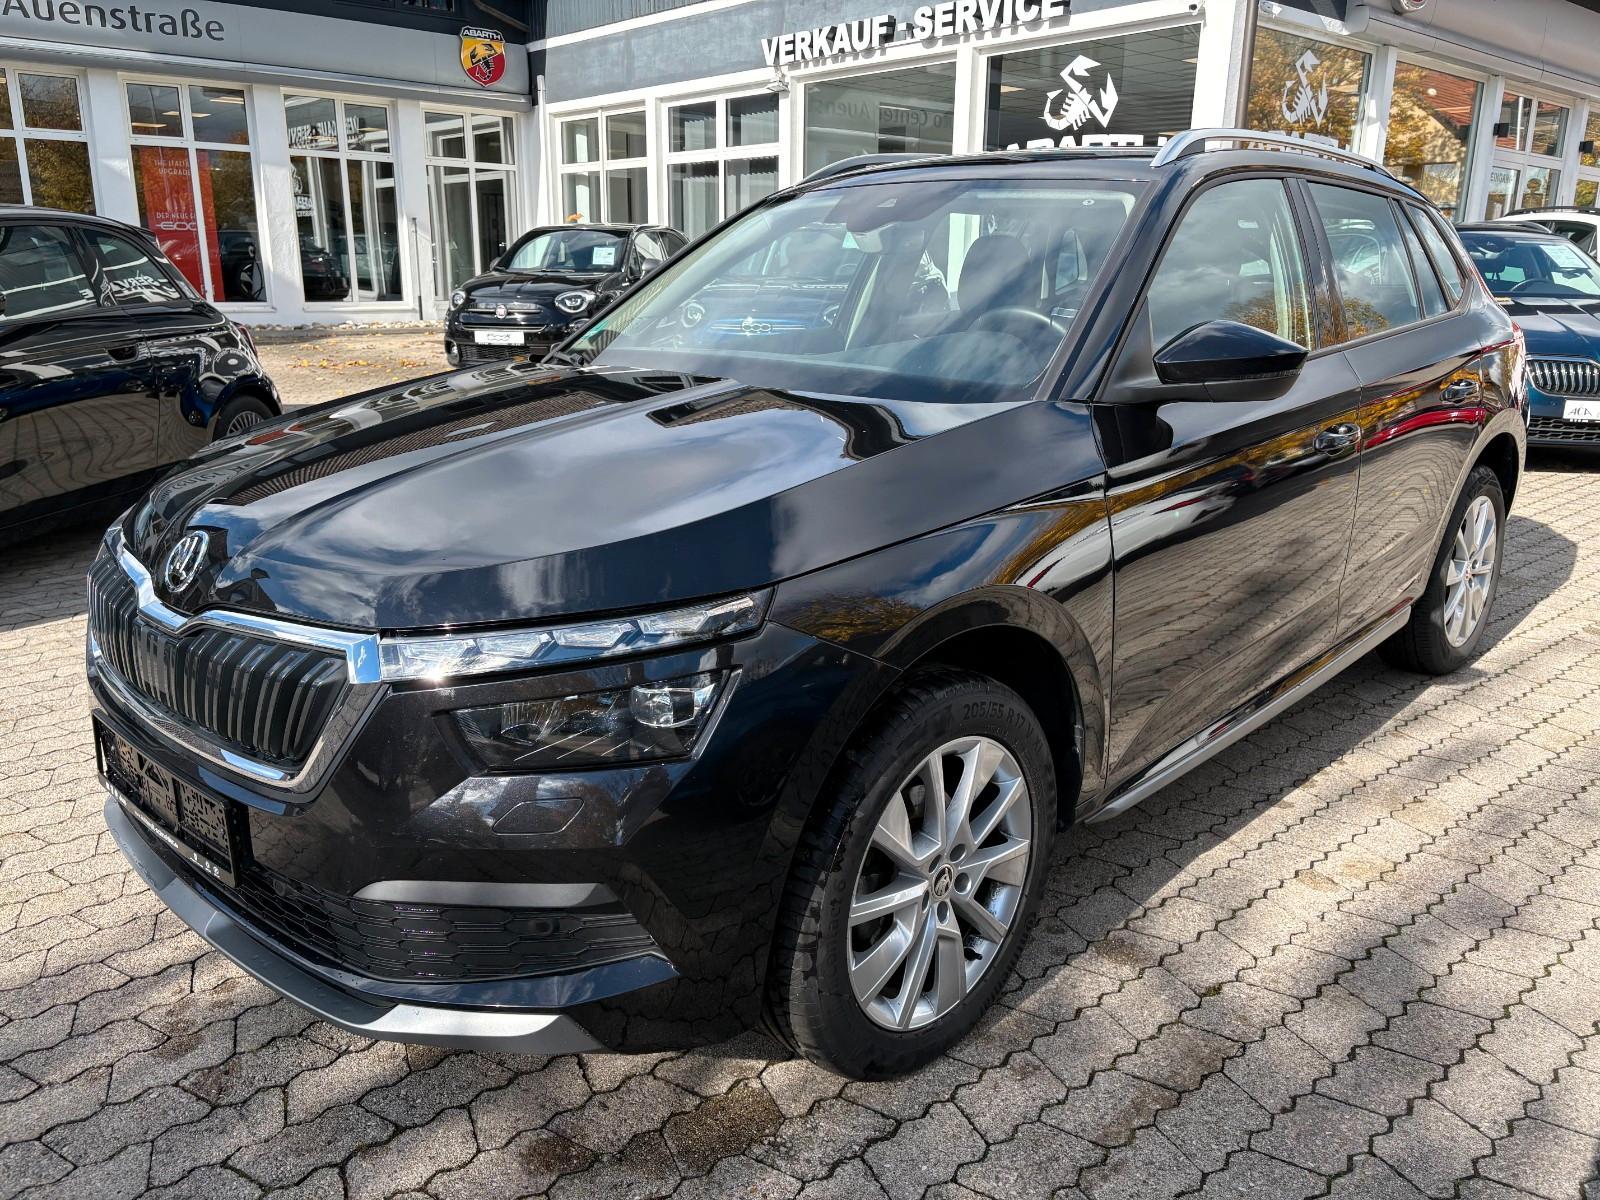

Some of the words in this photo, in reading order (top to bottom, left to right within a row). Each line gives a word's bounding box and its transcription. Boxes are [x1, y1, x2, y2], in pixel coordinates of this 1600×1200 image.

[2, 0, 225, 41] Auenstraße
[463, 29, 501, 40] ABARTH
[761, 14, 893, 66] VERKAUF
[913, 0, 1066, 41] SERVICE
[963, 701, 1005, 722] 205/55
